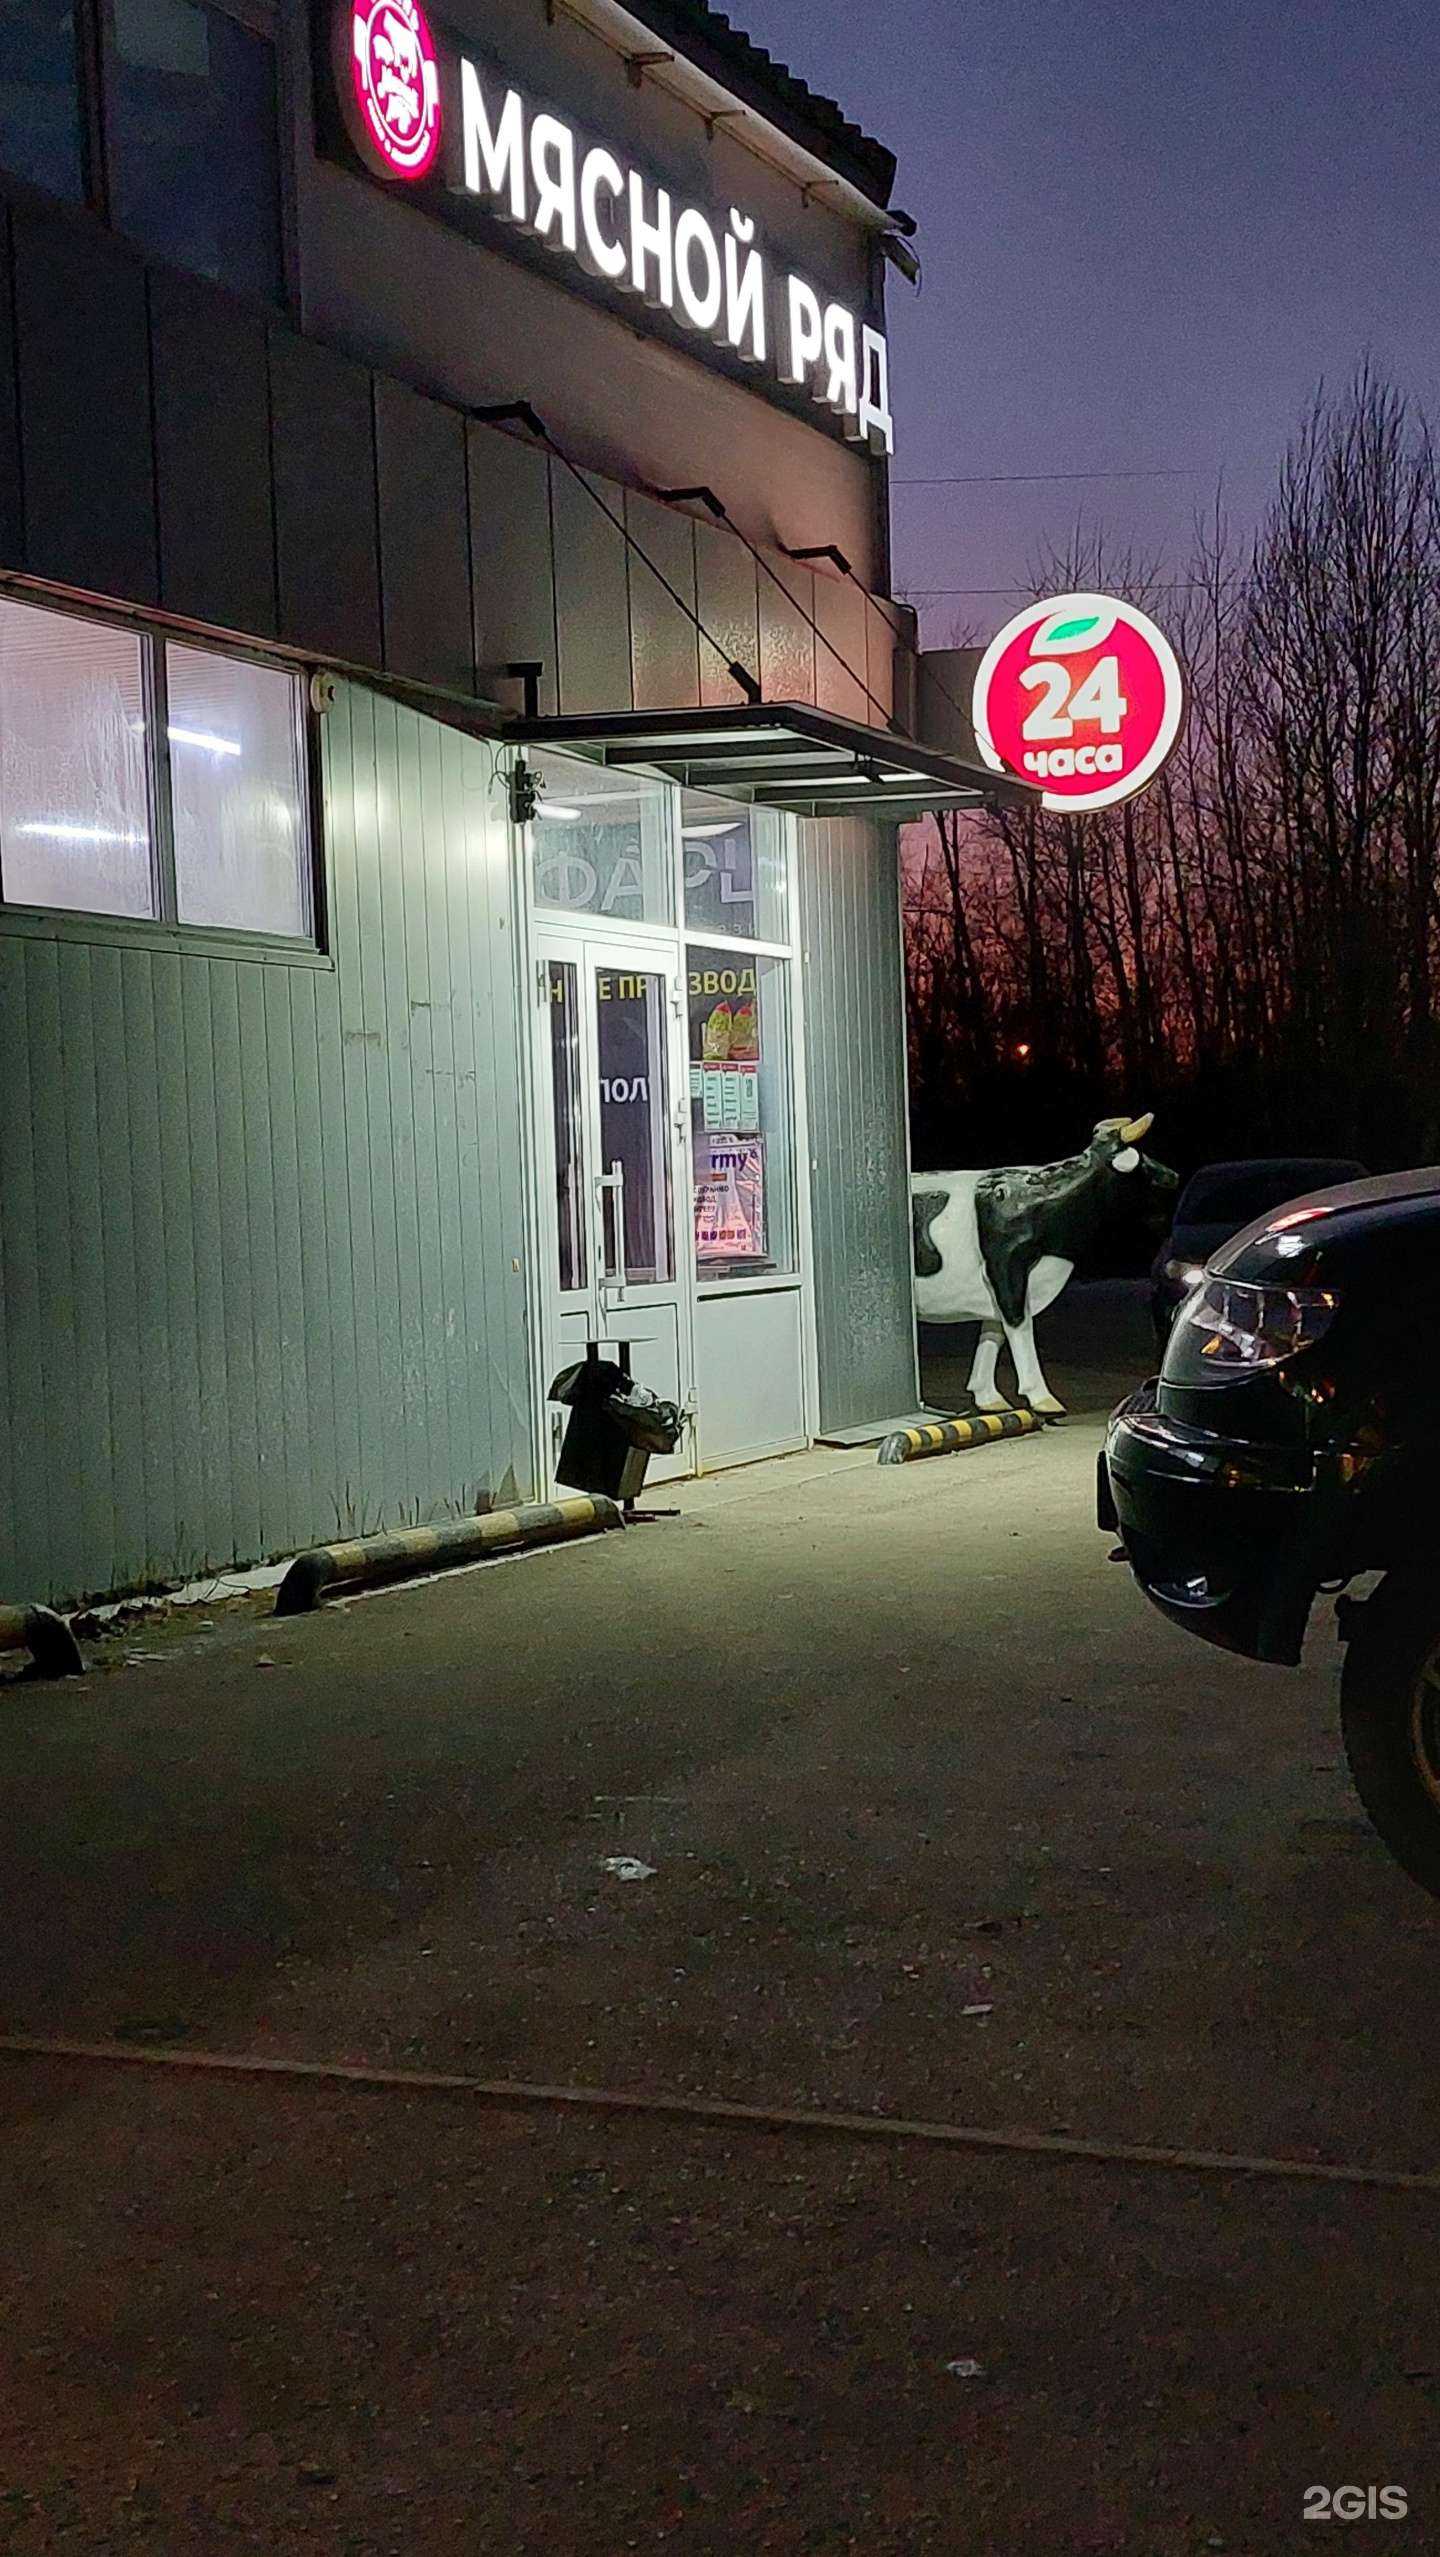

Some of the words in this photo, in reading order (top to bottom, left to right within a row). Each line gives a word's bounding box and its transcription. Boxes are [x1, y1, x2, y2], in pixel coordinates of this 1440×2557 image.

[460, 57, 766, 363] МЯСНОЙ
[787, 274, 895, 456] РЯД
[1019, 656, 1127, 741] 24
[1023, 744, 1123, 778] часа
